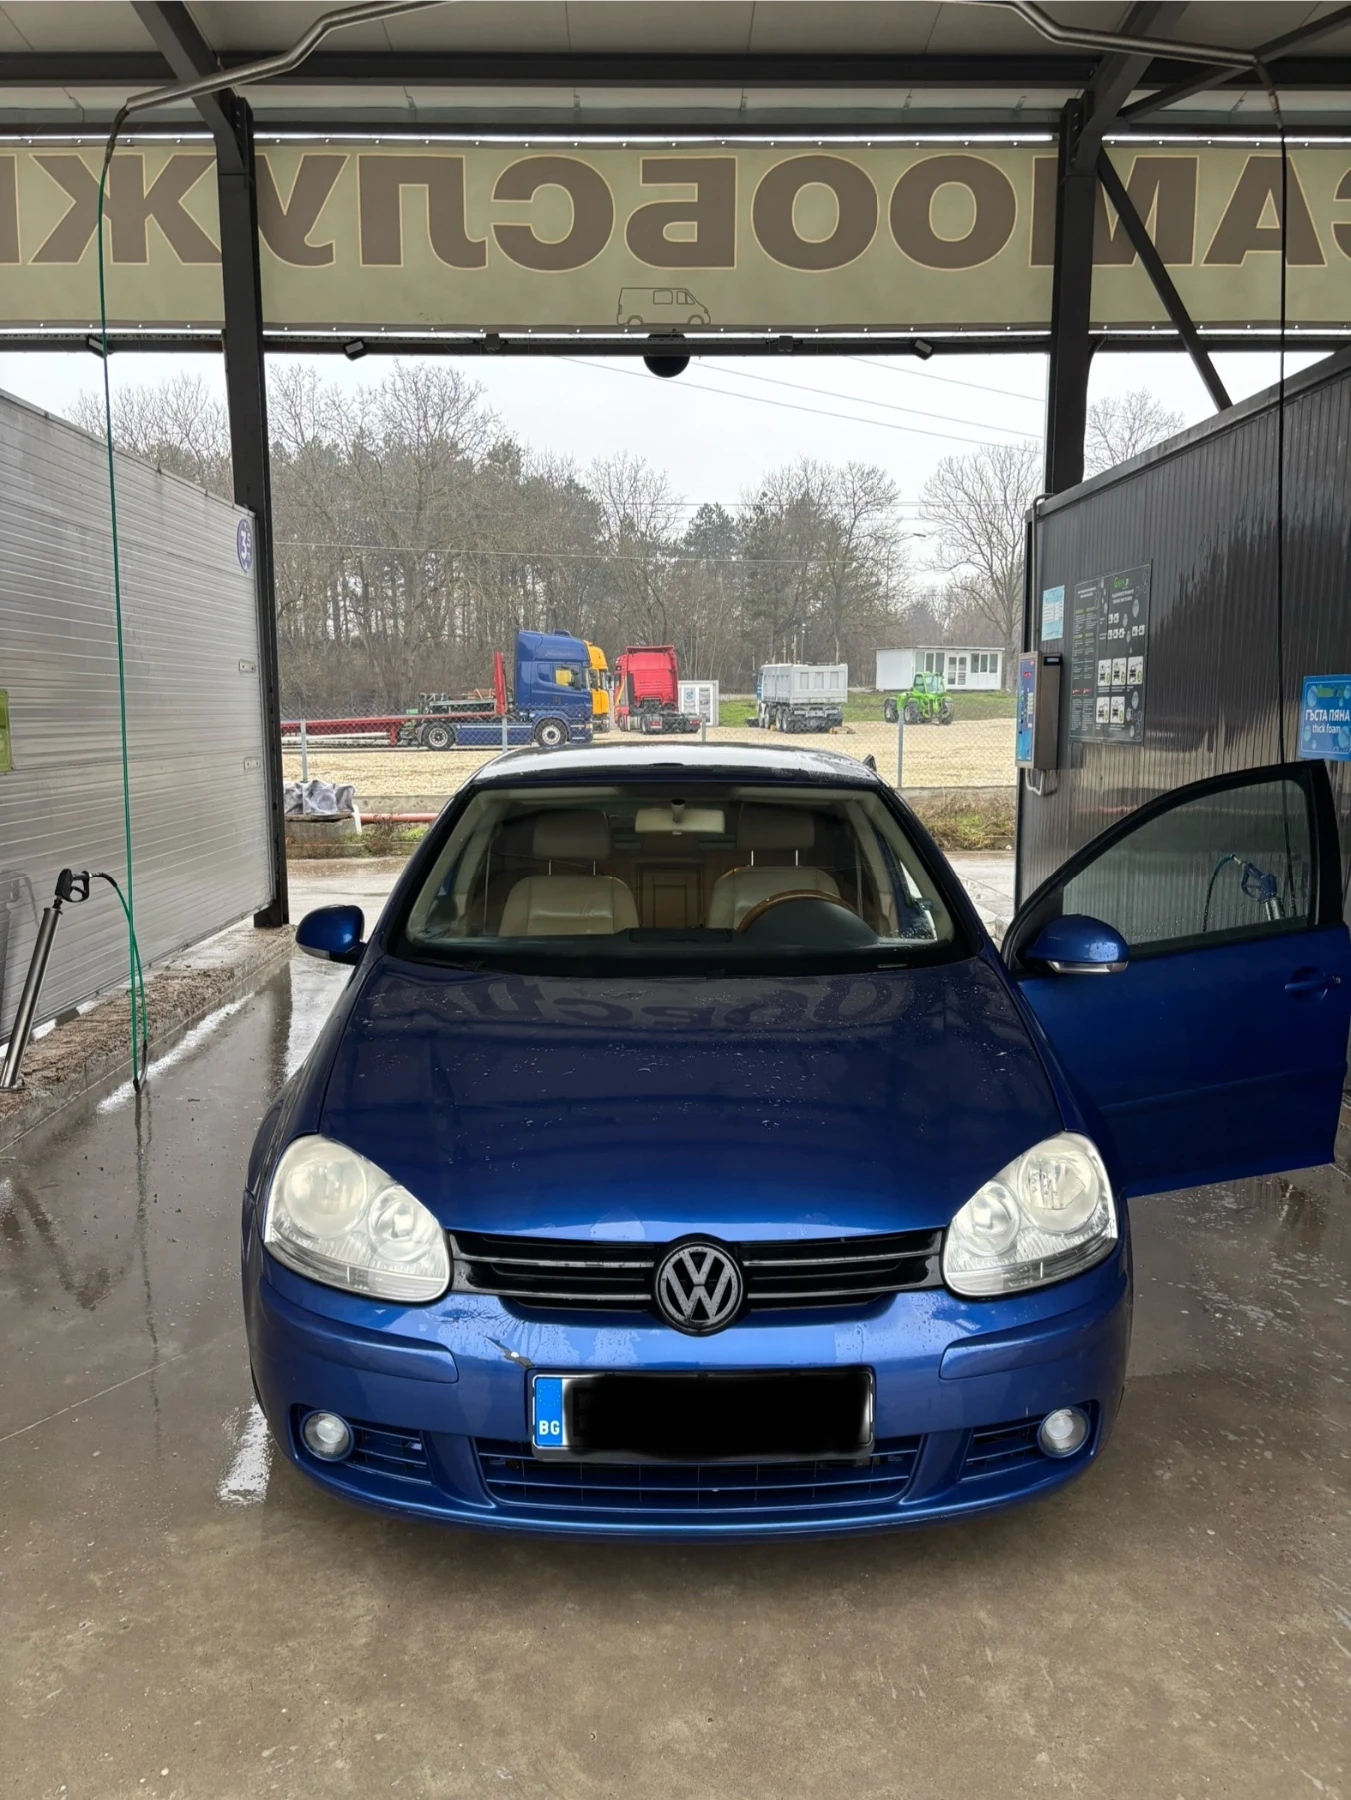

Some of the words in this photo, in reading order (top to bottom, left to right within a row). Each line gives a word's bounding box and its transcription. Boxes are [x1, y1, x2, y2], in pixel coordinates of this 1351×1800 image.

[1305, 709, 1328, 722] ГЪСТА
[1328, 709, 1350, 722] ПЯНА
[1312, 723, 1326, 733] thick
[1326, 722, 1341, 734] foam
[538, 1420, 561, 1436] BG
